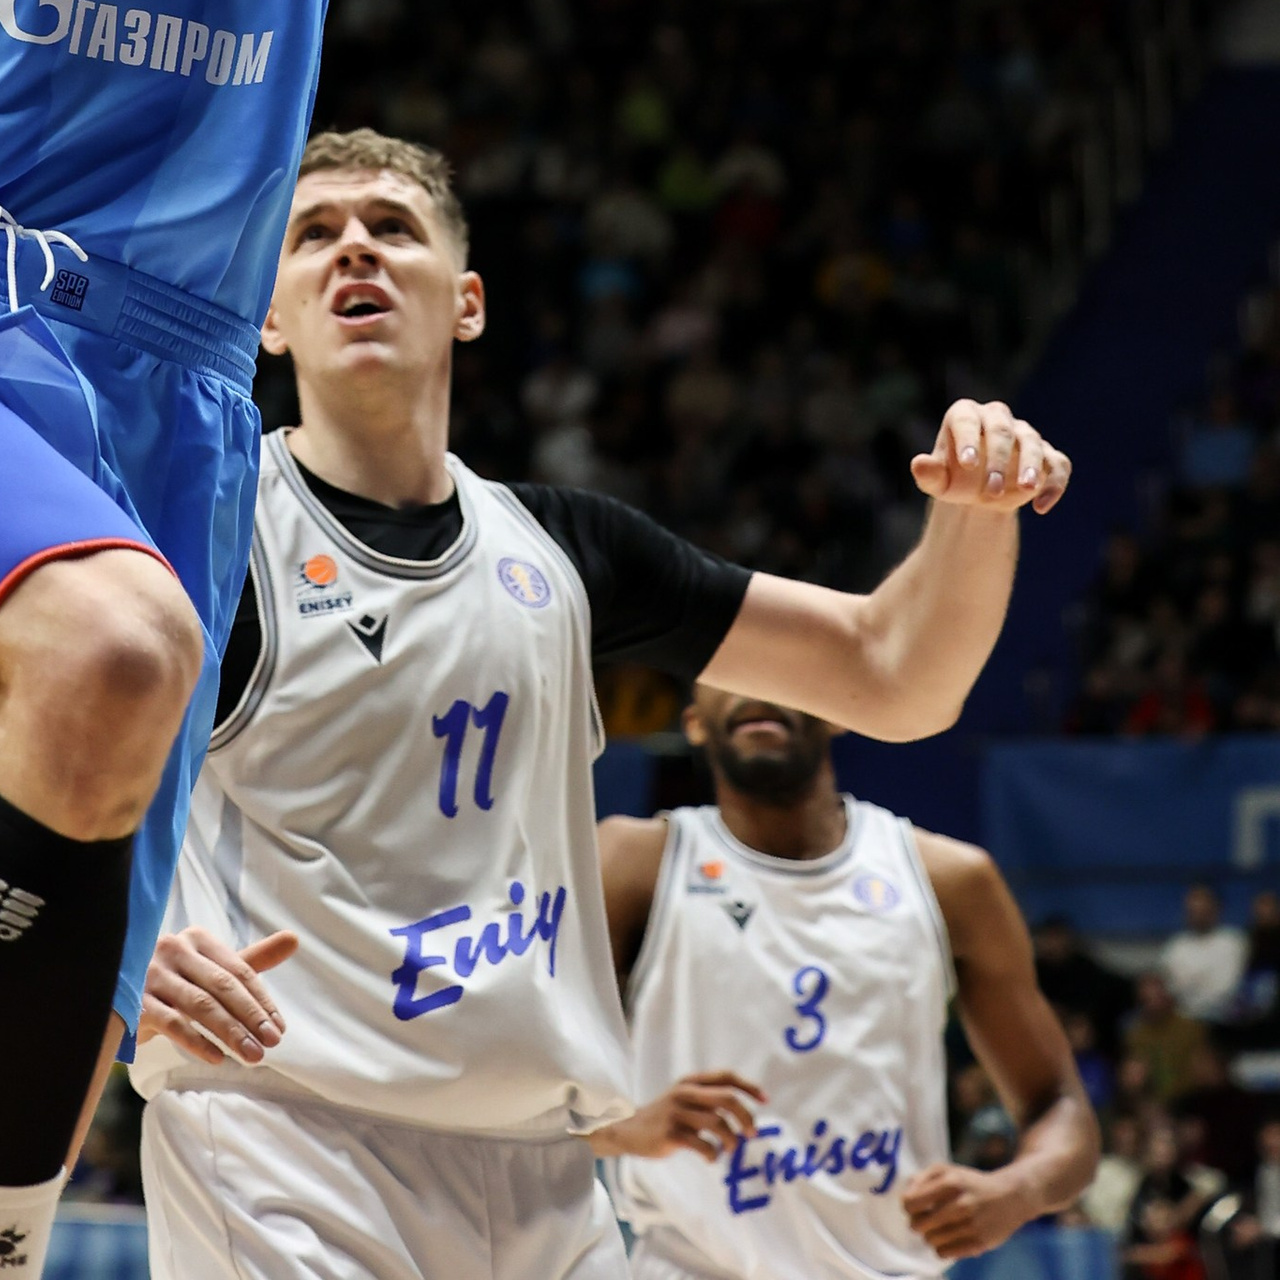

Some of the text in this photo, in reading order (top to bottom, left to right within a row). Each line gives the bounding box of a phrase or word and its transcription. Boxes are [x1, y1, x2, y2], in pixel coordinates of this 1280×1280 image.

[432, 691, 509, 819] 11
[784, 965, 830, 1053] 3
[724, 1119, 904, 1215] Enisey
